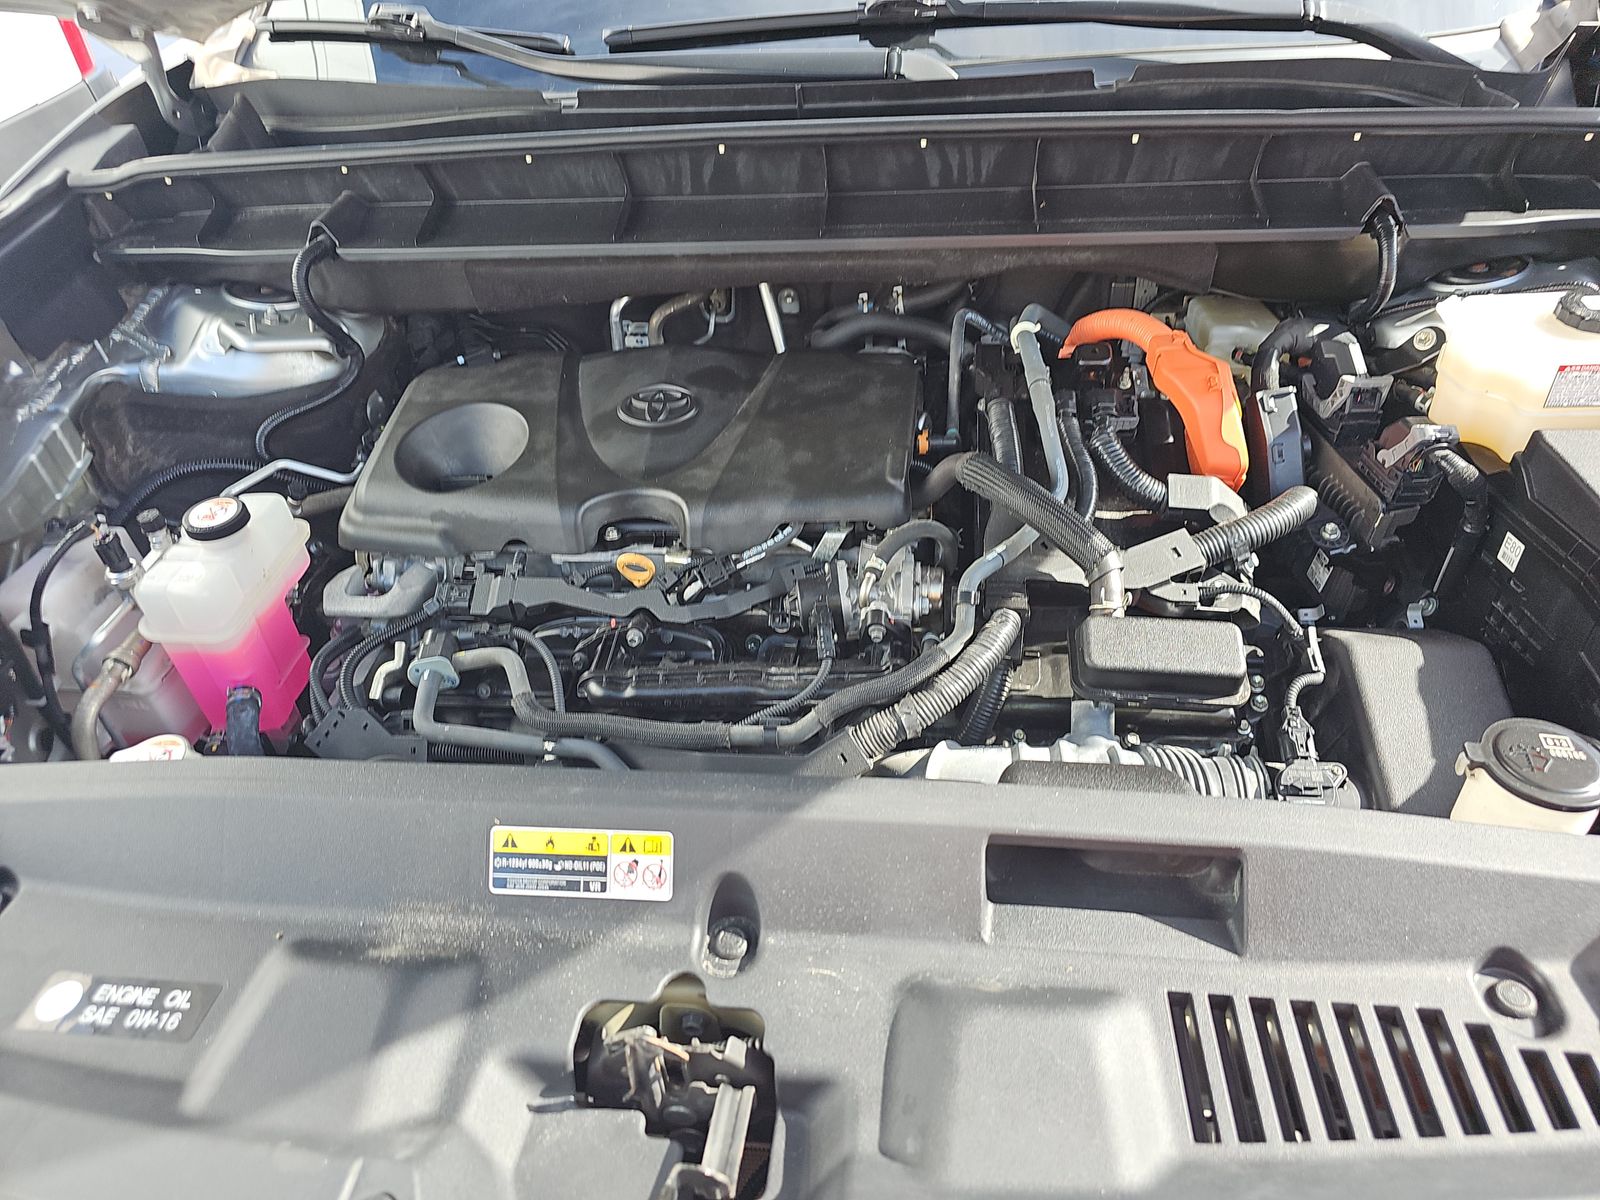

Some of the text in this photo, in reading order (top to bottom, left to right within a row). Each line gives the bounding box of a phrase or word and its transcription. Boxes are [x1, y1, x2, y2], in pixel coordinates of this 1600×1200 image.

[1503, 537, 1522, 558] E80
[91, 983, 192, 1010] ENGINE OIL
[78, 1005, 183, 1032] SAE 0W-16
